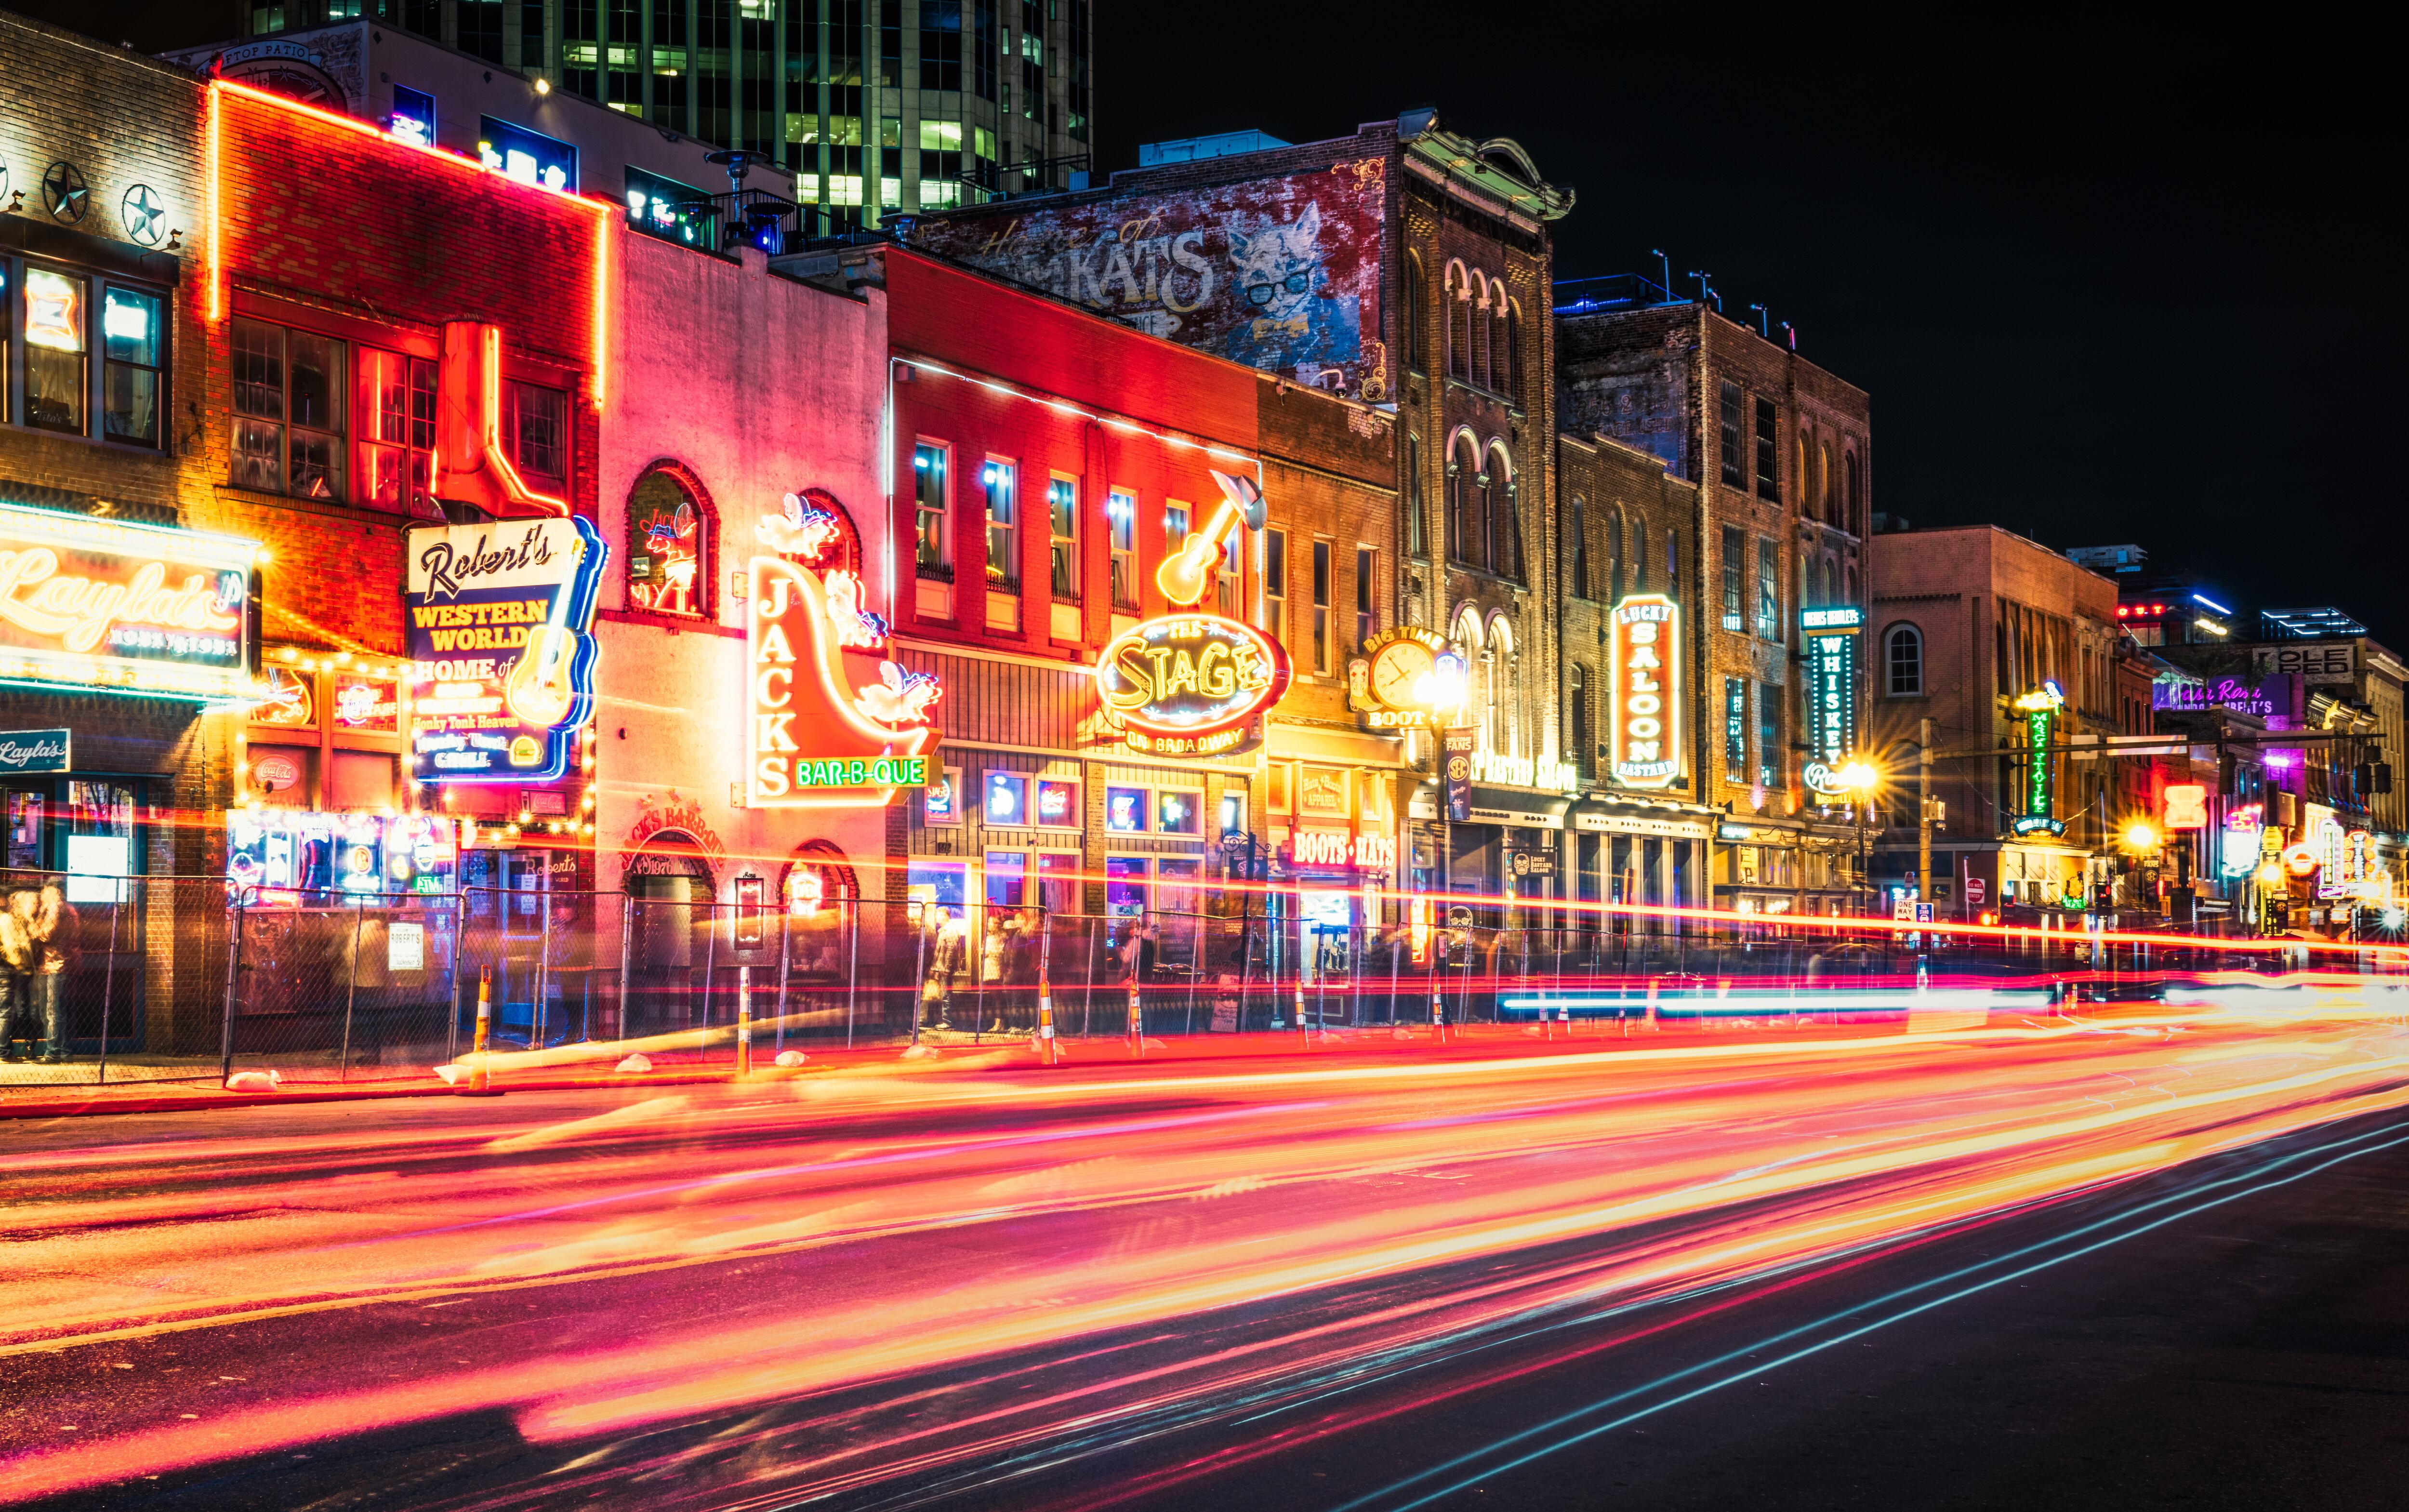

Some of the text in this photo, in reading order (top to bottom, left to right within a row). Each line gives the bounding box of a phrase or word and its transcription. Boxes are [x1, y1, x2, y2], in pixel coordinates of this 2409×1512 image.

[265, 45, 305, 58] PATIO
[421, 524, 554, 604] Robert's
[413, 600, 548, 628] WESTERN
[1618, 606, 1672, 624] LUCKY
[430, 627, 529, 651] WORLD
[1168, 621, 1203, 638] THE
[1363, 626, 1444, 653] BIG TIME
[2278, 649, 2348, 663] OLE
[415, 656, 516, 683] HOME of
[1108, 636, 1268, 710] STAGE
[2278, 662, 2348, 675] RED
[1628, 623, 1662, 762] SALOON
[1820, 637, 1842, 765] WHISKEY
[412, 715, 519, 733] Honky Tonk Heaven
[1127, 728, 1244, 754] ON BROADWAY
[1446, 742, 1472, 751] FANS
[0, 740, 66, 767] Layla's
[797, 758, 926, 785] BAR-B-QUE
[1450, 759, 1467, 779] SEC
[1618, 760, 1675, 777] BASTARD
[1303, 774, 1342, 793] Hats Boots
[1308, 794, 1337, 808] APPAREL
[1294, 832, 1395, 867] BOOTS HATS
[525, 854, 576, 876] Robert's
[651, 860, 673, 875] 1976
[417, 876, 443, 893] ATM
